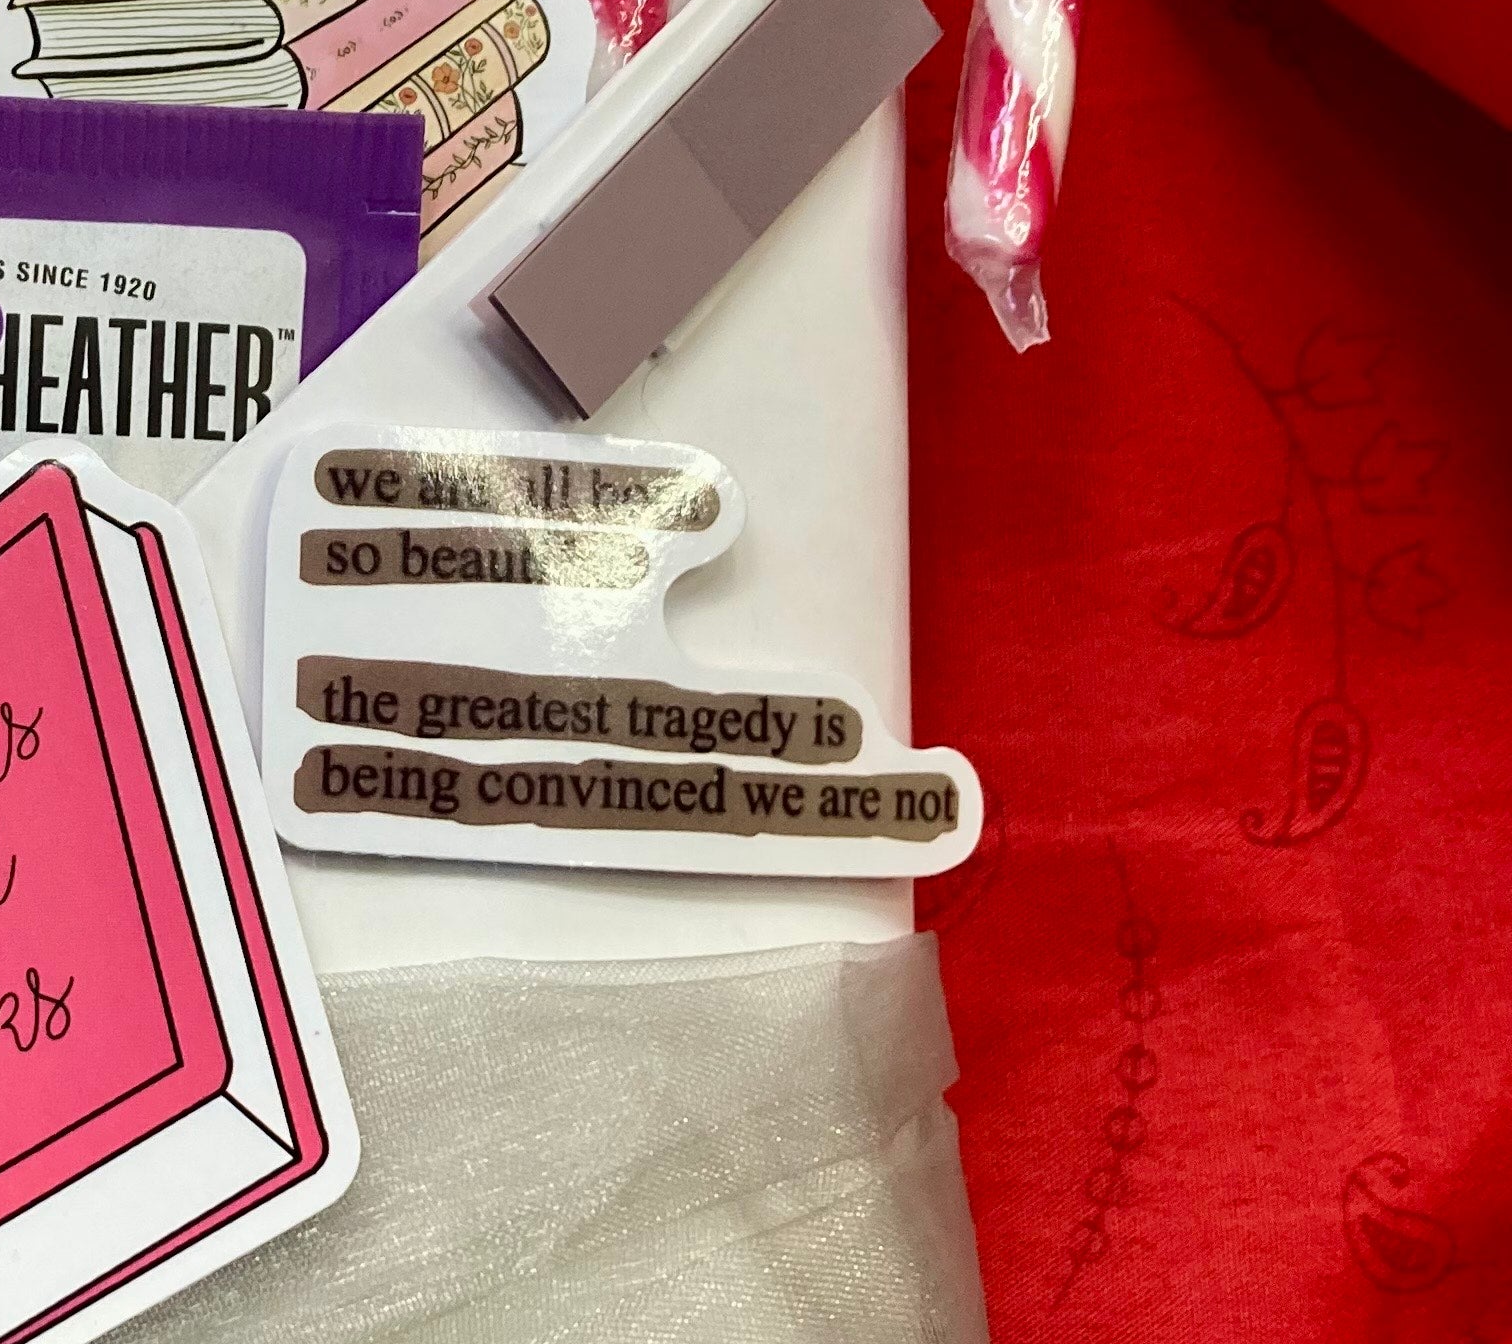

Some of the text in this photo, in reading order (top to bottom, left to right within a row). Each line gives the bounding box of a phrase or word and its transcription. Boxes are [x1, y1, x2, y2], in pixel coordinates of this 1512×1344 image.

[16, 261, 89, 289] SINCE
[100, 272, 157, 301] 1920
[328, 467, 402, 505] we
[325, 530, 578, 586] so beaut
[322, 676, 847, 757] the greatest tragedy is
[320, 750, 957, 824] being convinced we are not
